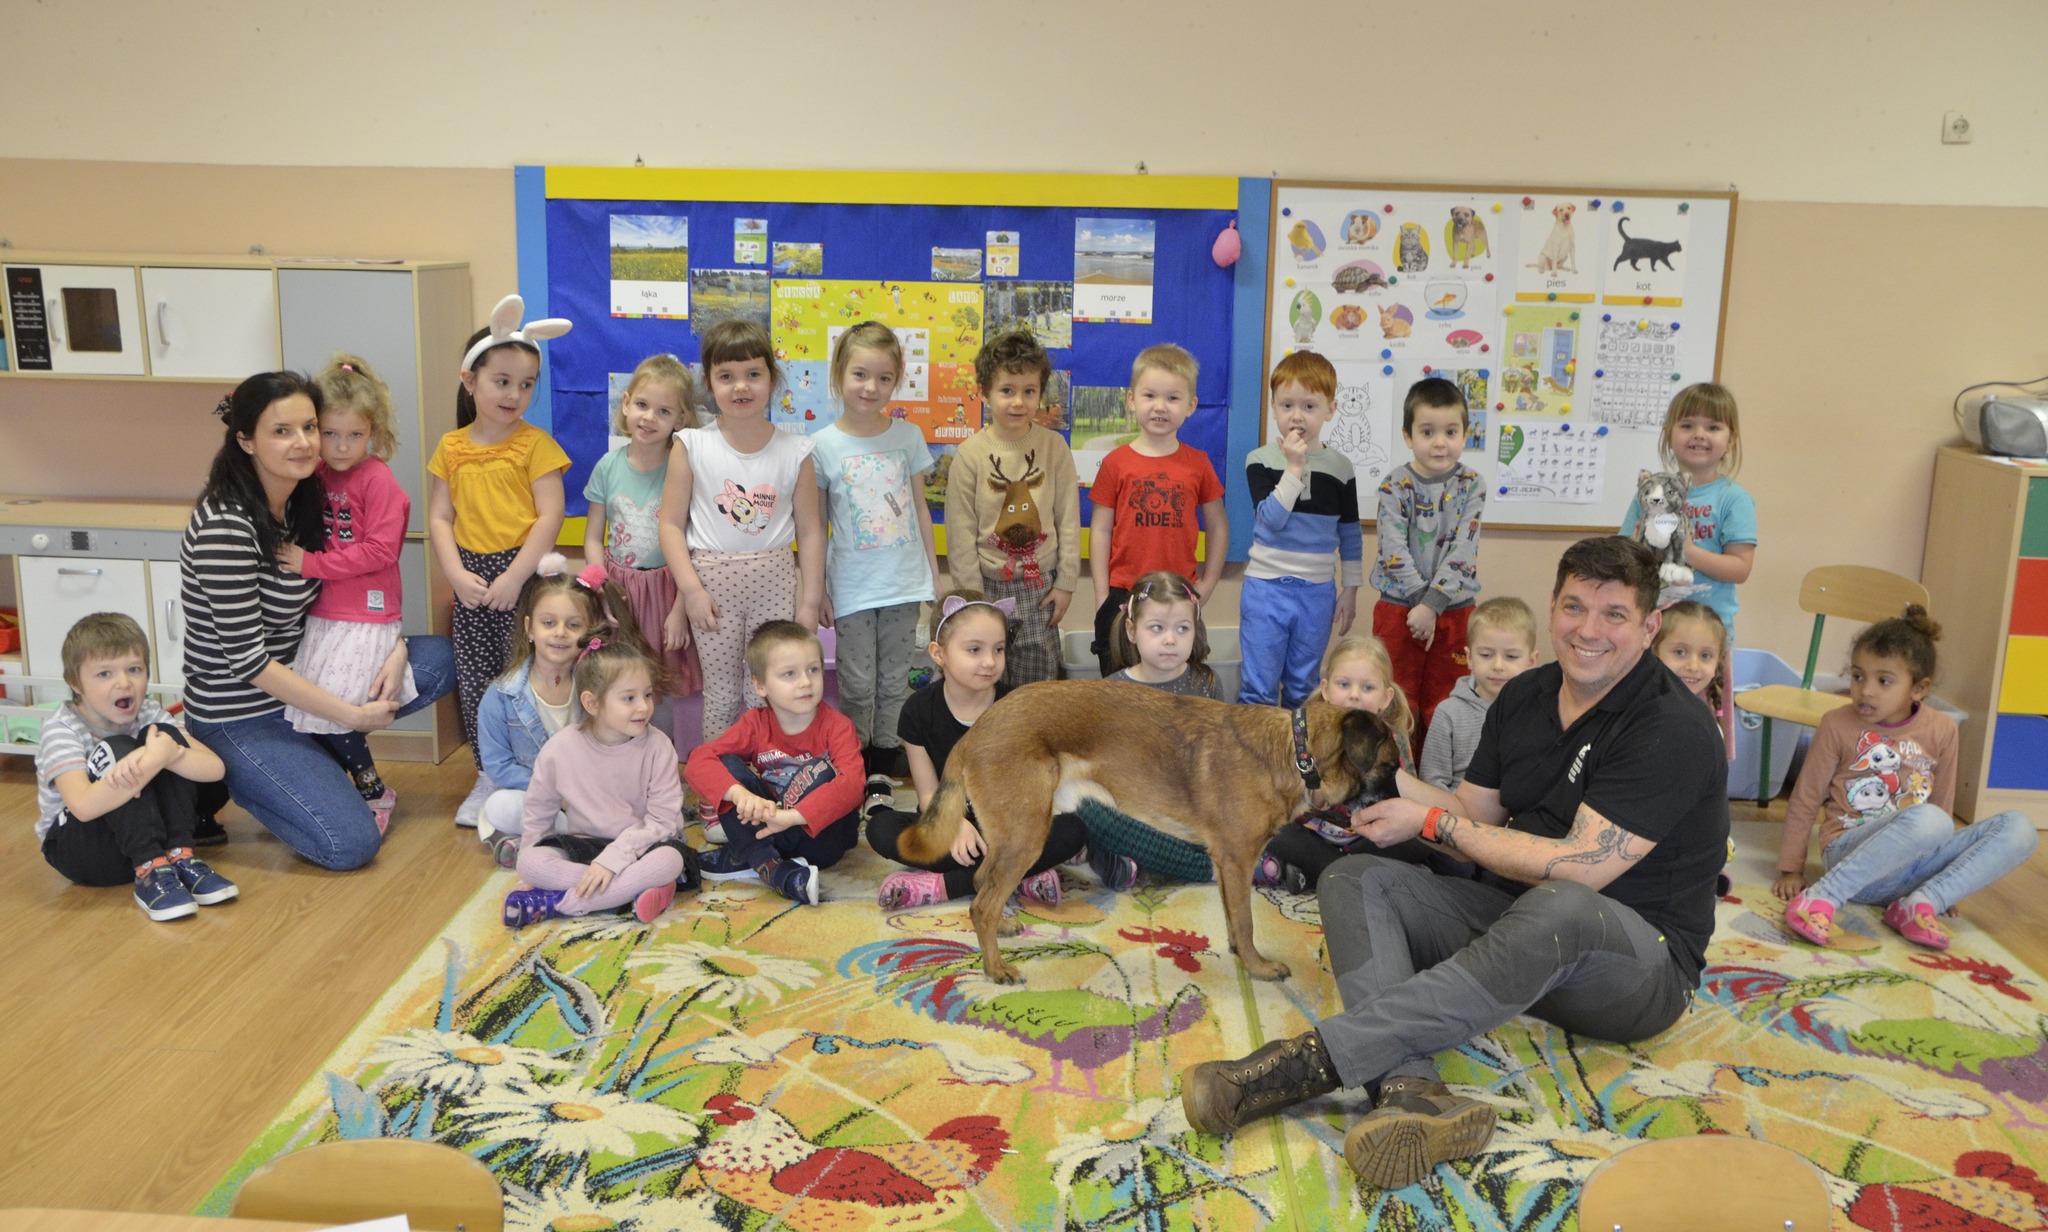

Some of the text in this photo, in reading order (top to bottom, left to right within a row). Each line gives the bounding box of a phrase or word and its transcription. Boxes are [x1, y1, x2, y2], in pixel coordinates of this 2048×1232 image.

[1546, 279, 1566, 288] pies
[1636, 281, 1651, 291] kot
[641, 290, 658, 299] łąka
[753, 493, 776, 502] MINNIE
[753, 500, 774, 508] MOUSE
[1135, 512, 1171, 527] RIDE
